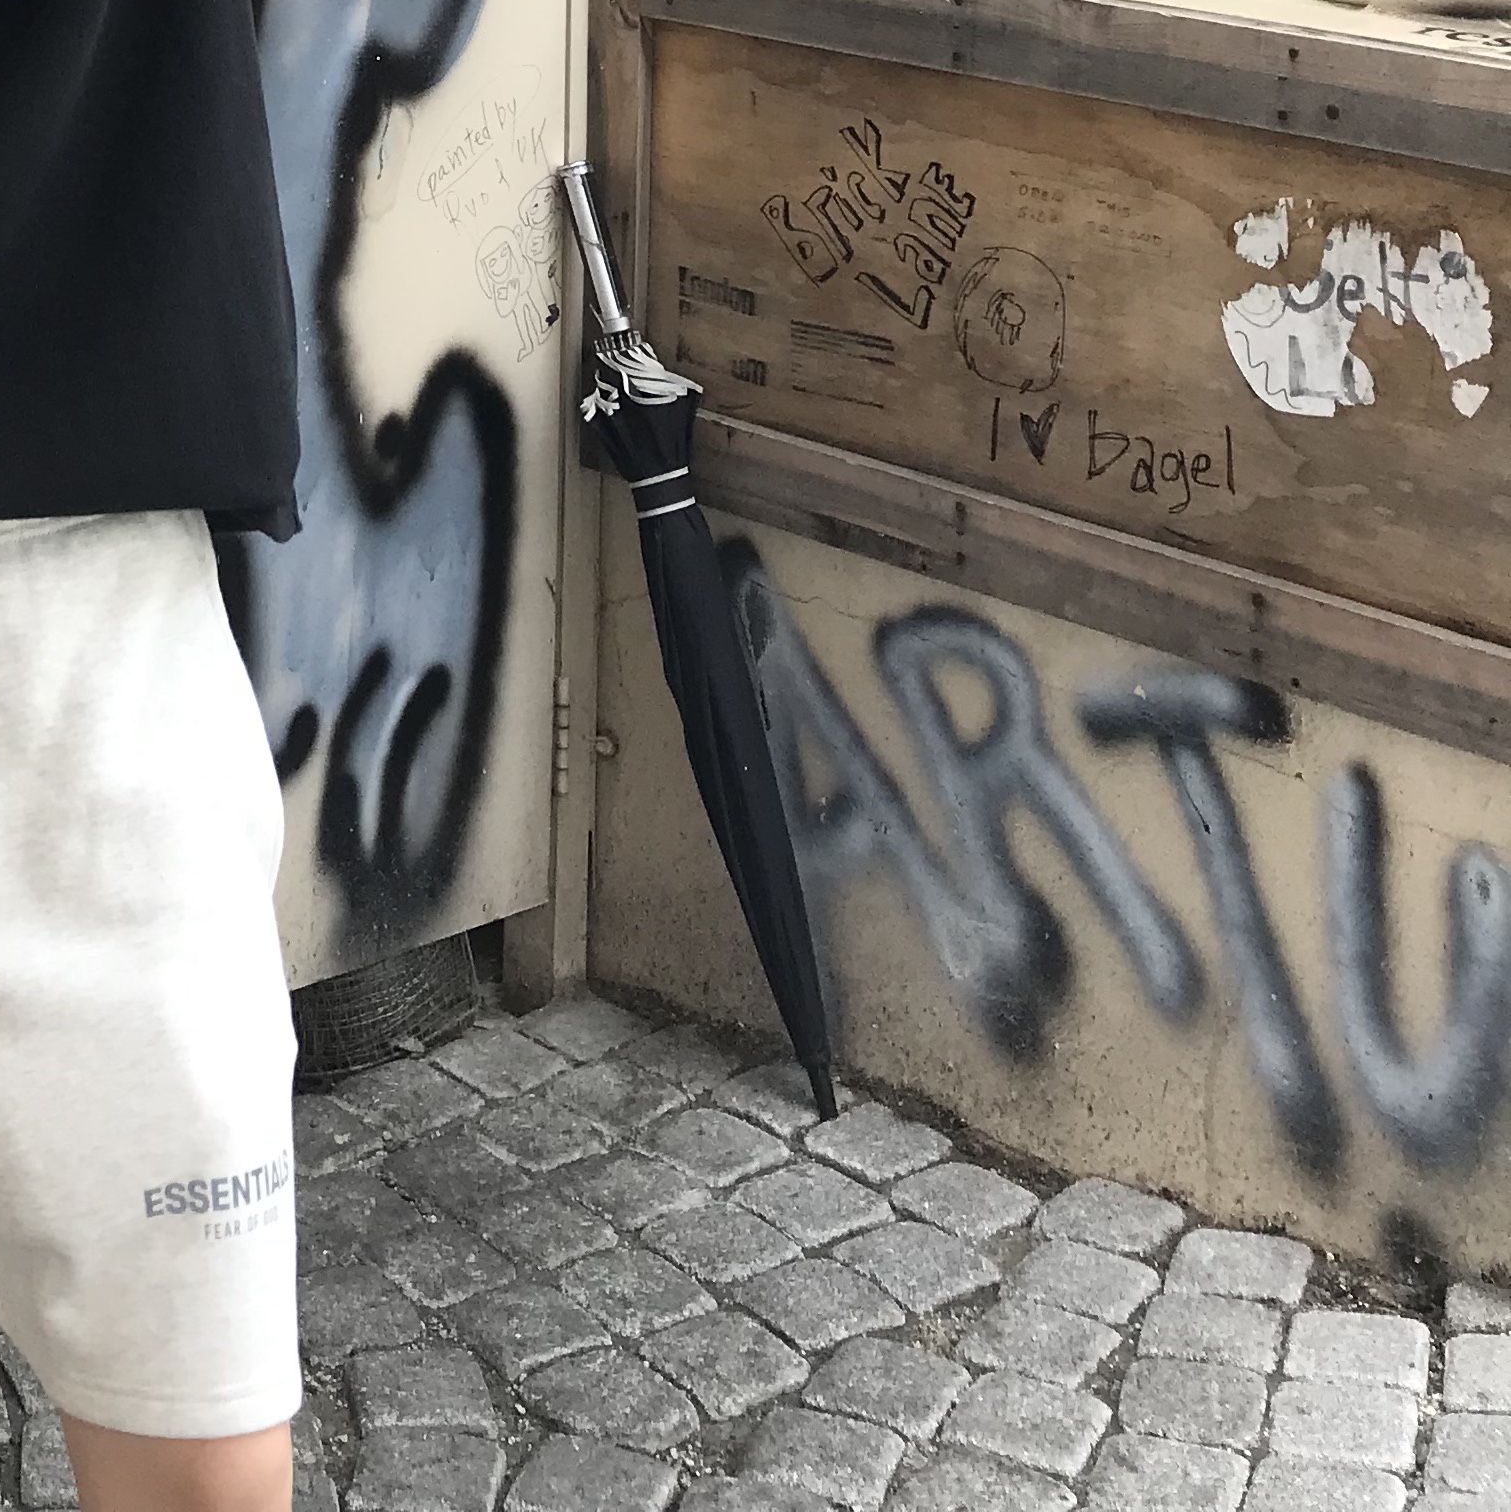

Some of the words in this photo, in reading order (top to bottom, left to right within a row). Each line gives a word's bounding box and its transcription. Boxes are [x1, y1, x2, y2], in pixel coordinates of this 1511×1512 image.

[428, 101, 492, 208] painted
[990, 397, 1000, 463] I
[1086, 409, 1236, 515] bagel
[204, 1220, 241, 1240] FEAR
